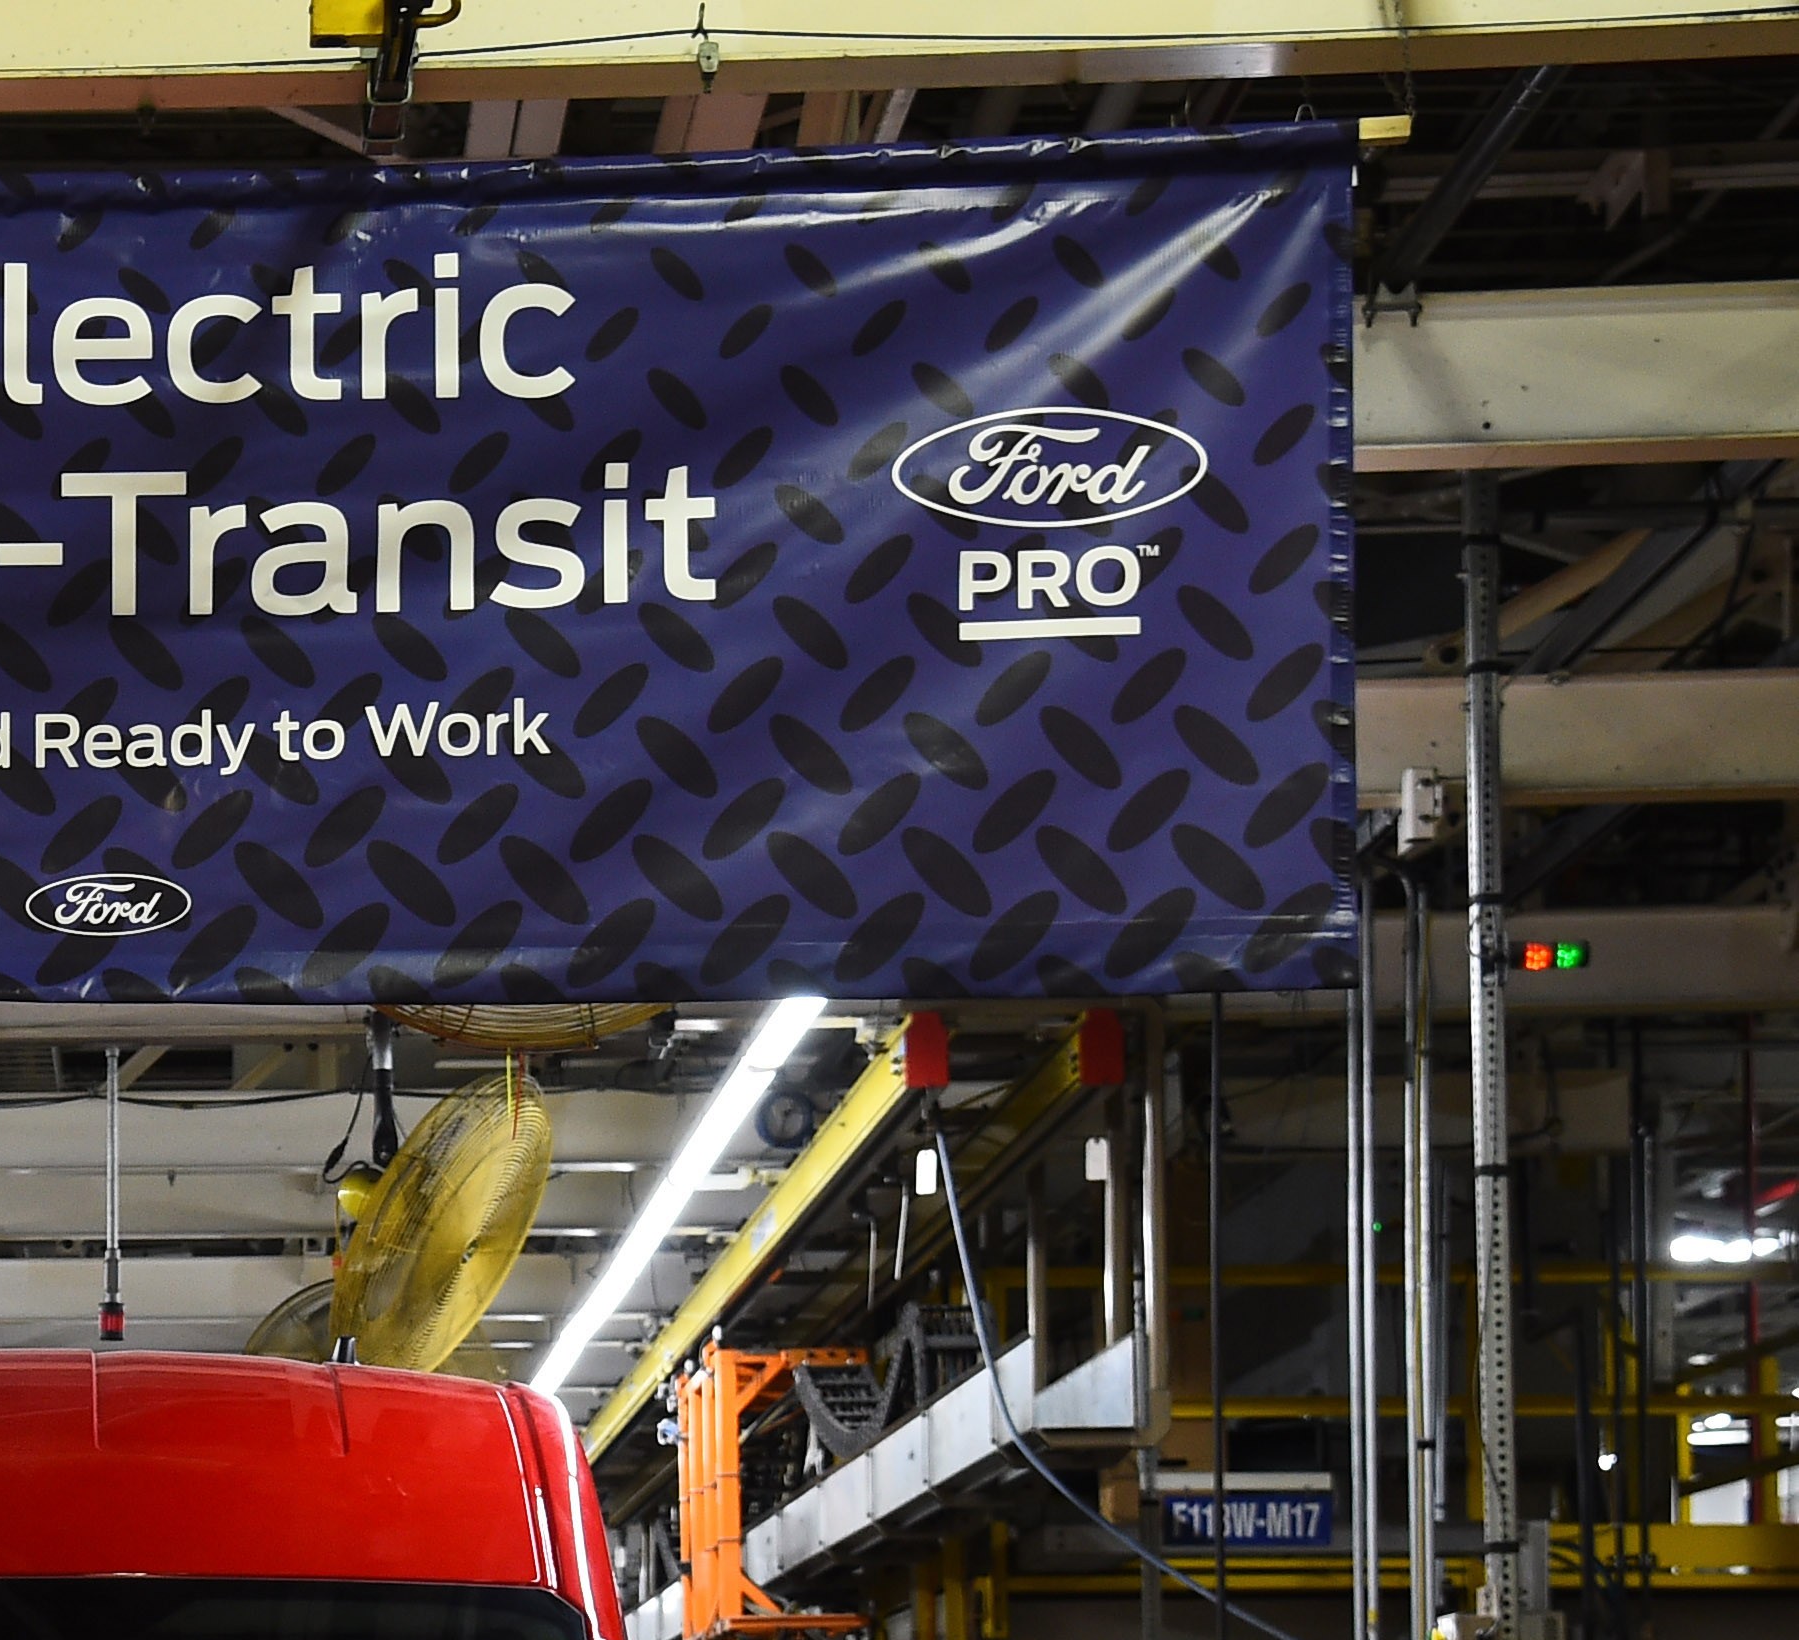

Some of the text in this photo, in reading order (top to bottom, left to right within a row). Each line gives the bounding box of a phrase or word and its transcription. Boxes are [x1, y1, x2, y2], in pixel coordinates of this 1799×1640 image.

[947, 423, 1152, 506] Ford
[35, 708, 256, 776] Ready
[272, 710, 345, 761] to
[364, 697, 551, 757] Work
[53, 881, 165, 926] Ford
